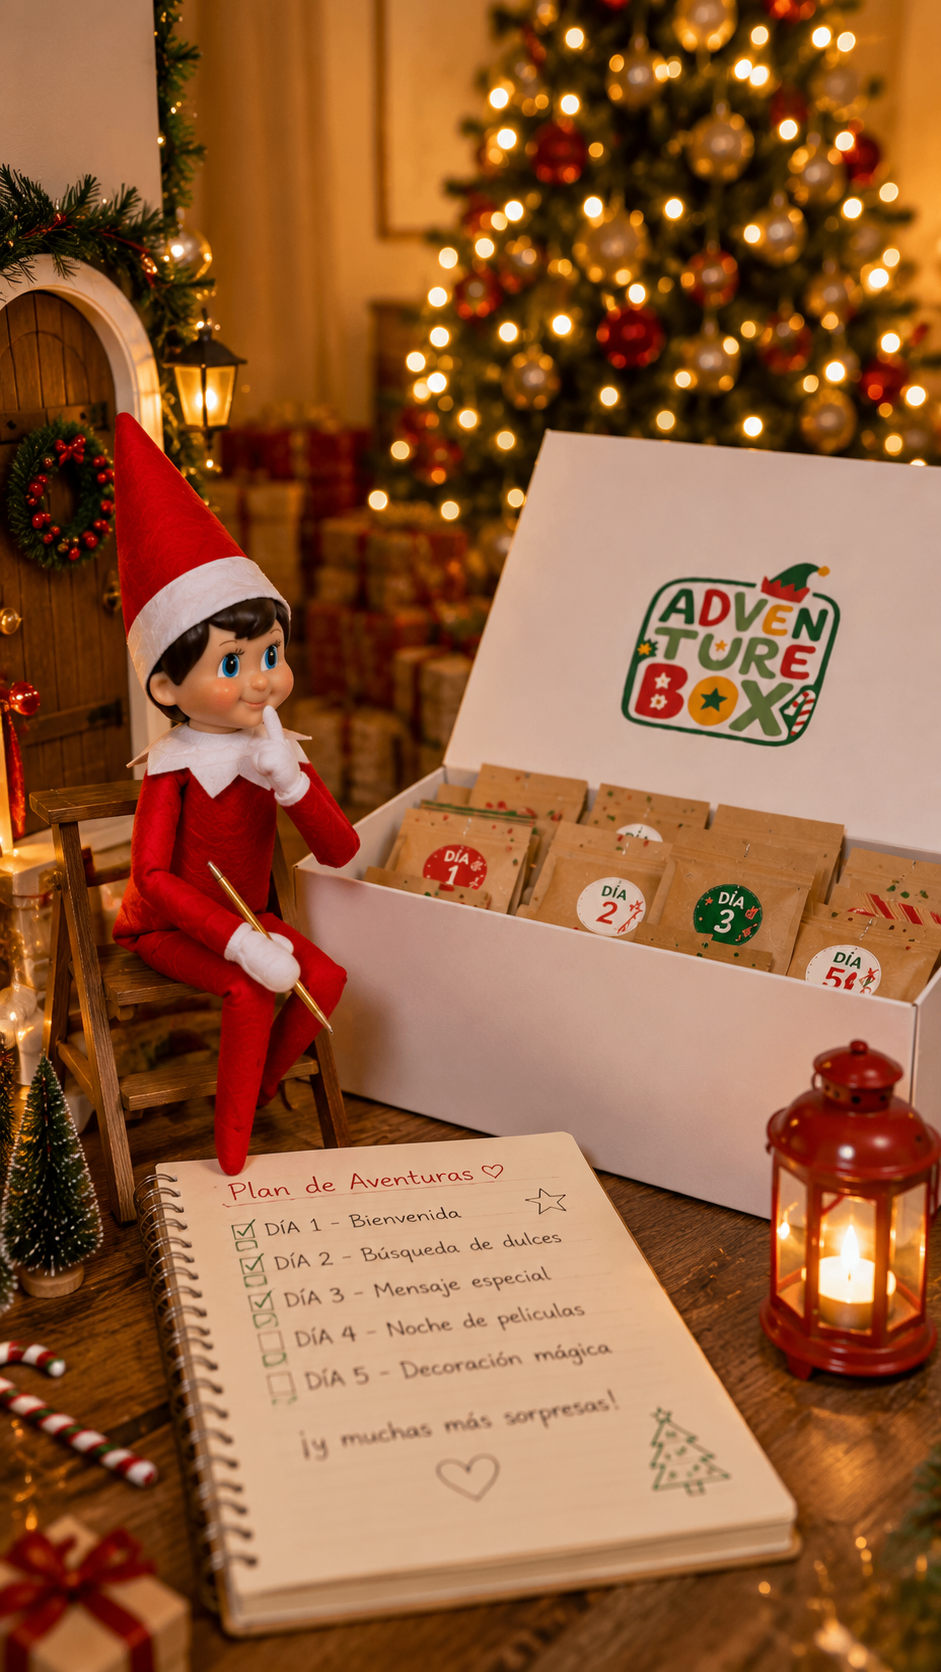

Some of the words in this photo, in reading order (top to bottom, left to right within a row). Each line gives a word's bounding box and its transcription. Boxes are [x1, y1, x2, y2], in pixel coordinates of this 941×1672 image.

[658, 588, 829, 642] ADVEN
[654, 626, 817, 680] TURE
[634, 663, 794, 737] BOX
[444, 849, 469, 865] DÍA
[445, 865, 458, 885] 1
[601, 880, 627, 901] DÍA
[595, 901, 618, 925] 2
[713, 909, 735, 934] 3
[228, 1181, 290, 1200] Plan
[305, 1176, 336, 1194] de
[350, 1170, 474, 1190] Aventuras
[264, 1219, 300, 1236] DÍA
[310, 1218, 322, 1232] 1
[349, 1206, 462, 1228] Bienvenida
[274, 1252, 311, 1270] DÍA
[319, 1252, 334, 1266] 2
[361, 1240, 460, 1263] Búsqueda
[470, 1237, 494, 1251] de
[503, 1232, 562, 1249] dulces
[284, 1288, 322, 1308] DÍA
[329, 1287, 345, 1303] 3
[374, 1278, 461, 1298] Mensaje
[471, 1266, 552, 1292] especial
[294, 1327, 334, 1347] DÍA
[341, 1325, 357, 1342] 4
[386, 1317, 453, 1338] Noche
[462, 1312, 488, 1329] de
[305, 1368, 346, 1391] DÍA
[353, 1366, 370, 1386] 5
[400, 1351, 524, 1380] Decoración
[534, 1343, 613, 1367] mágica
[340, 1420, 433, 1447] muchas
[444, 1411, 493, 1434] más
[504, 1388, 620, 1429] sorpresas!
